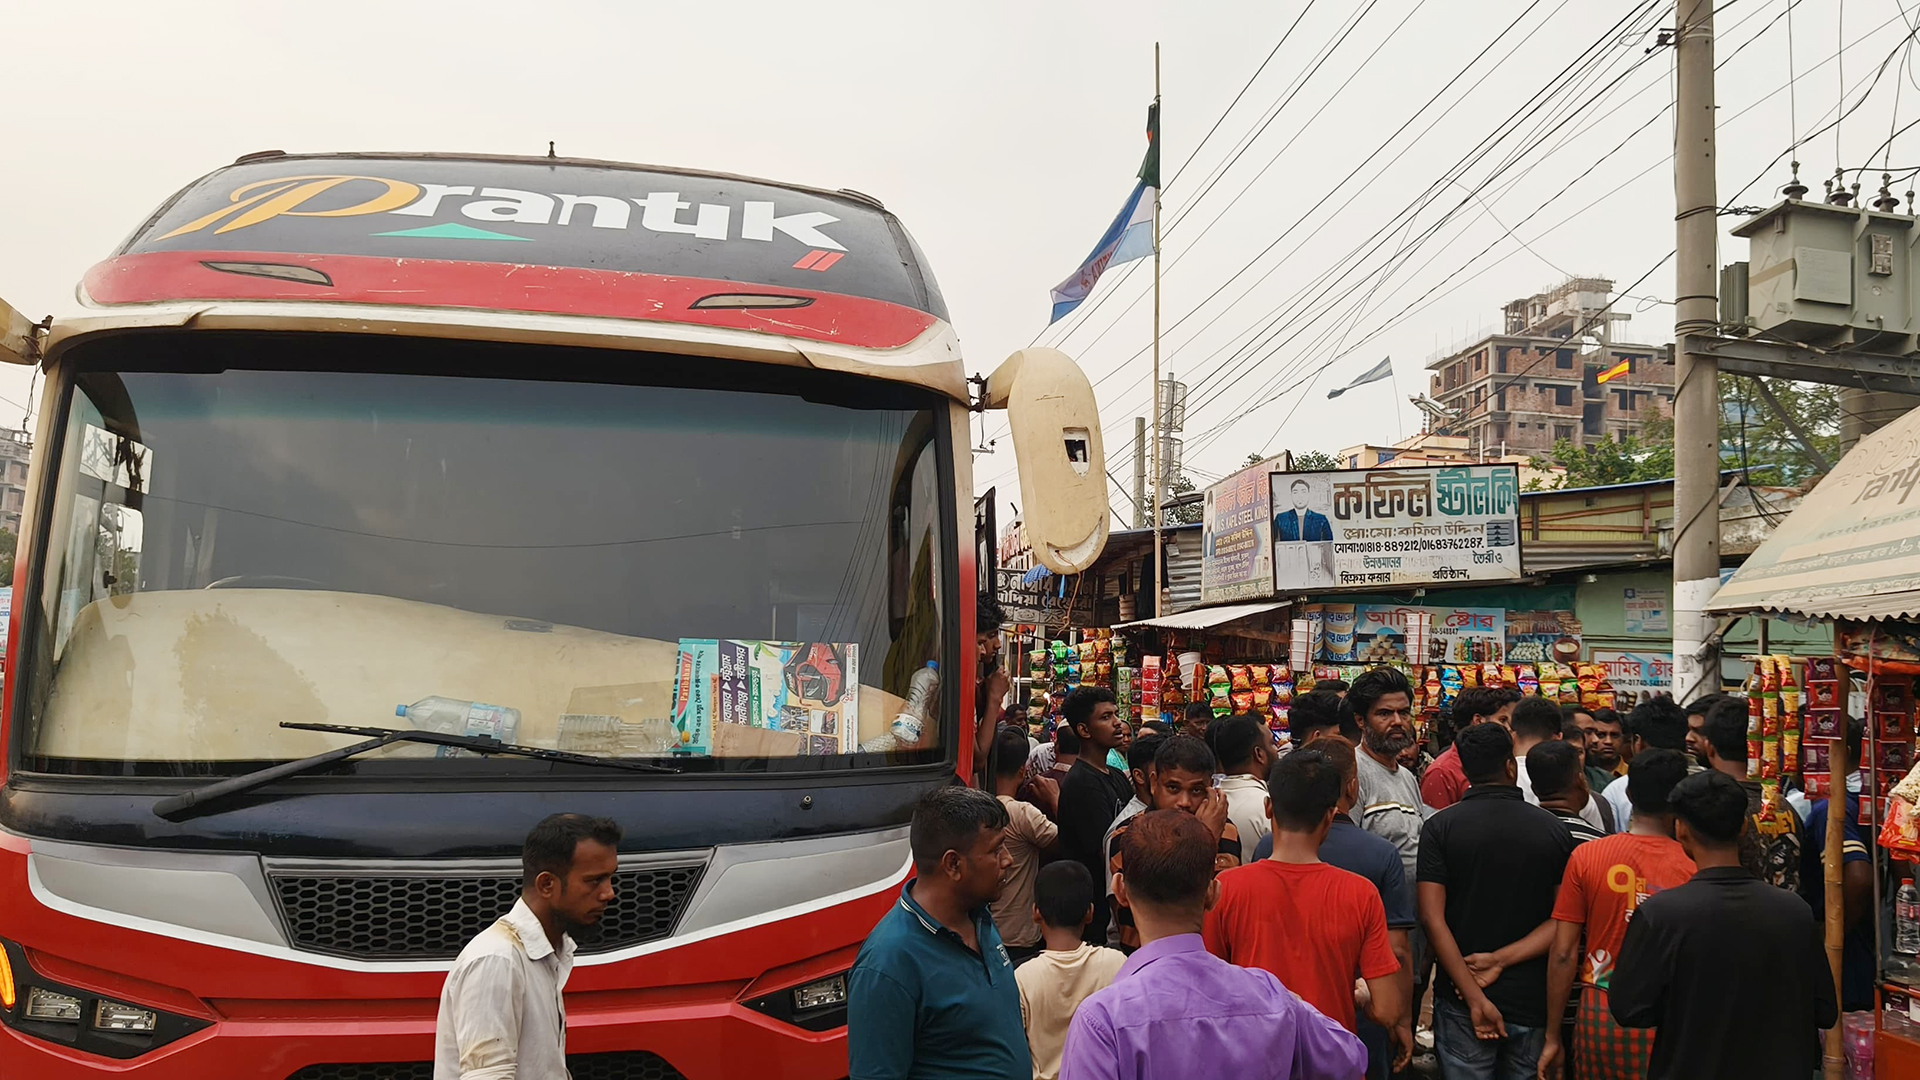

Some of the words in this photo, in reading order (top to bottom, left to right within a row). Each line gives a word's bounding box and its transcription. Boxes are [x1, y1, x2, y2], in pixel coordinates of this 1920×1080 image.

[1333, 473, 1432, 520] কফিল
[1238, 509, 1254, 526] STEEL
[1254, 503, 1268, 520] KING
[1340, 571, 1366, 585] বিক্রয়
[1367, 572, 1391, 583] করার
[680, 662, 691, 702] Paribahan
